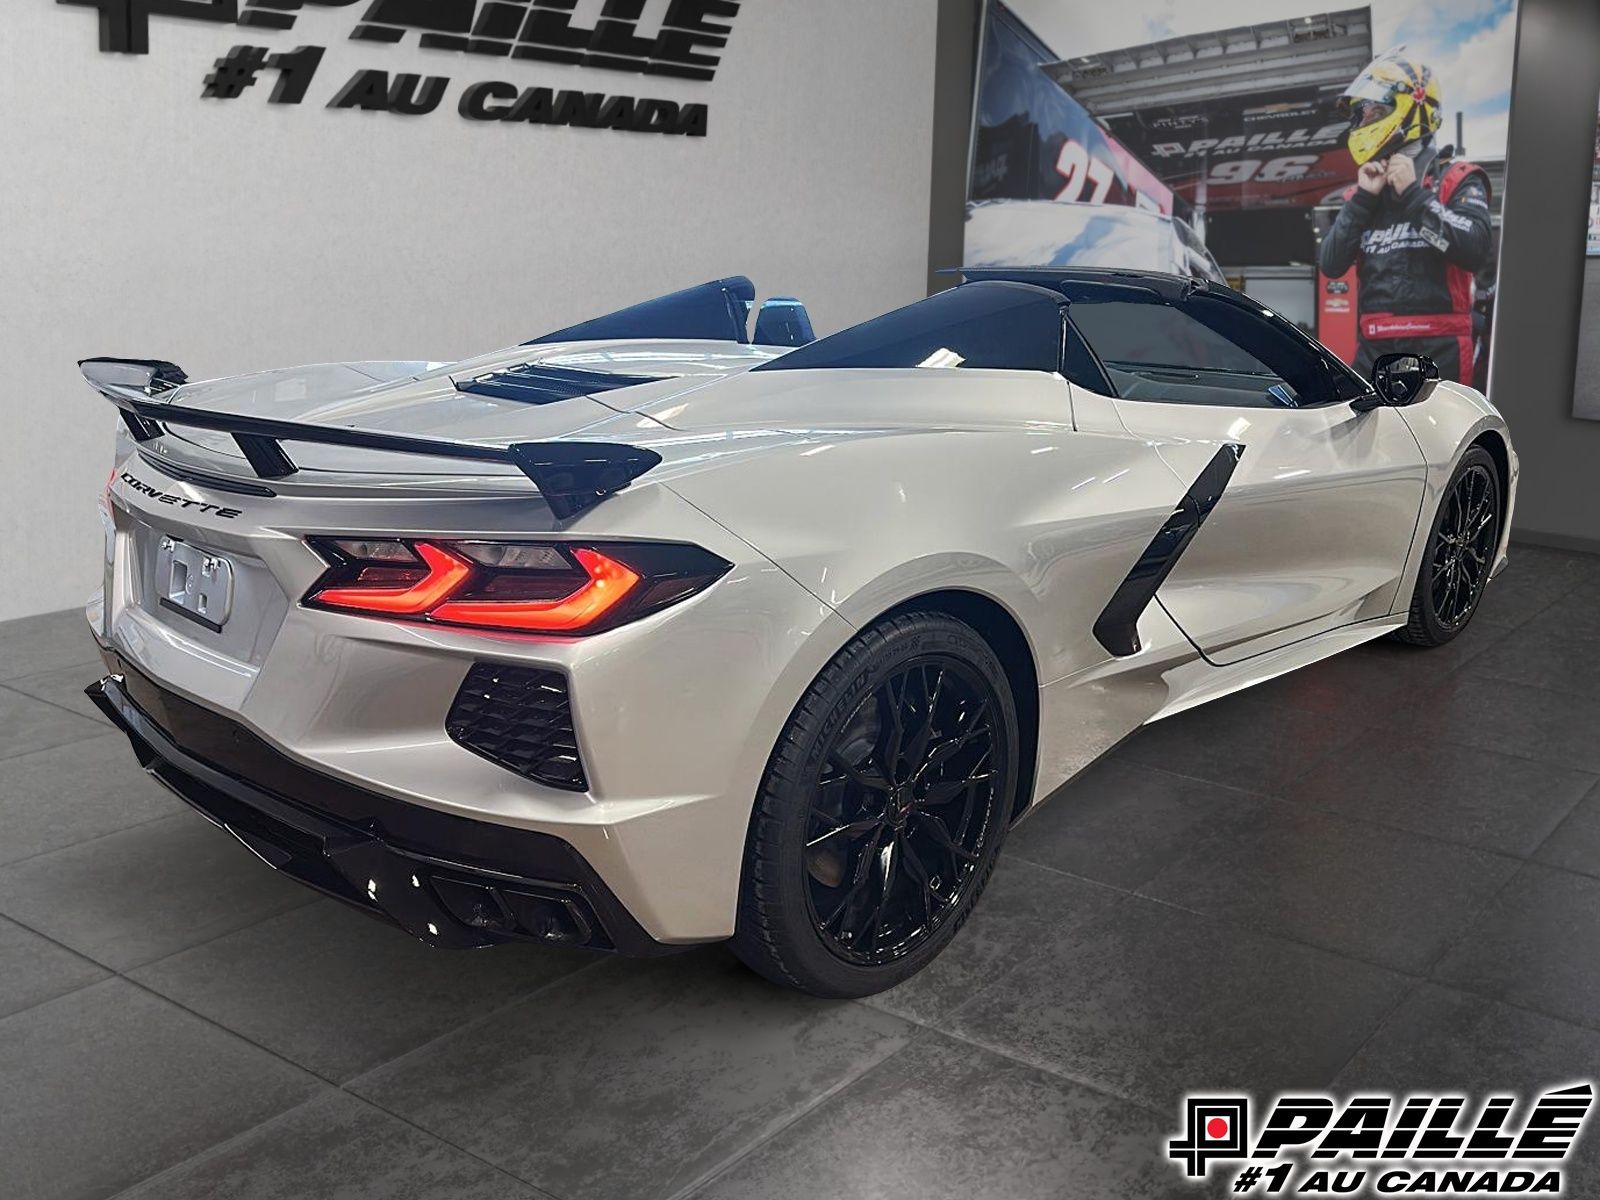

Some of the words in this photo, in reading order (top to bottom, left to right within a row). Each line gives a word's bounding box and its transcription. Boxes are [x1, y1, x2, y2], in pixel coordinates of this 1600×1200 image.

[200, 45, 327, 104] #1
[325, 69, 451, 115] AU
[457, 80, 708, 137] CANADA
[1243, 109, 1319, 123] CHEVROLET
[1212, 147, 1240, 155] AU
[1246, 138, 1338, 152] CANADA
[1054, 138, 1115, 206] 27
[1206, 155, 1320, 185] 96
[120, 472, 242, 519] CORVETTE
